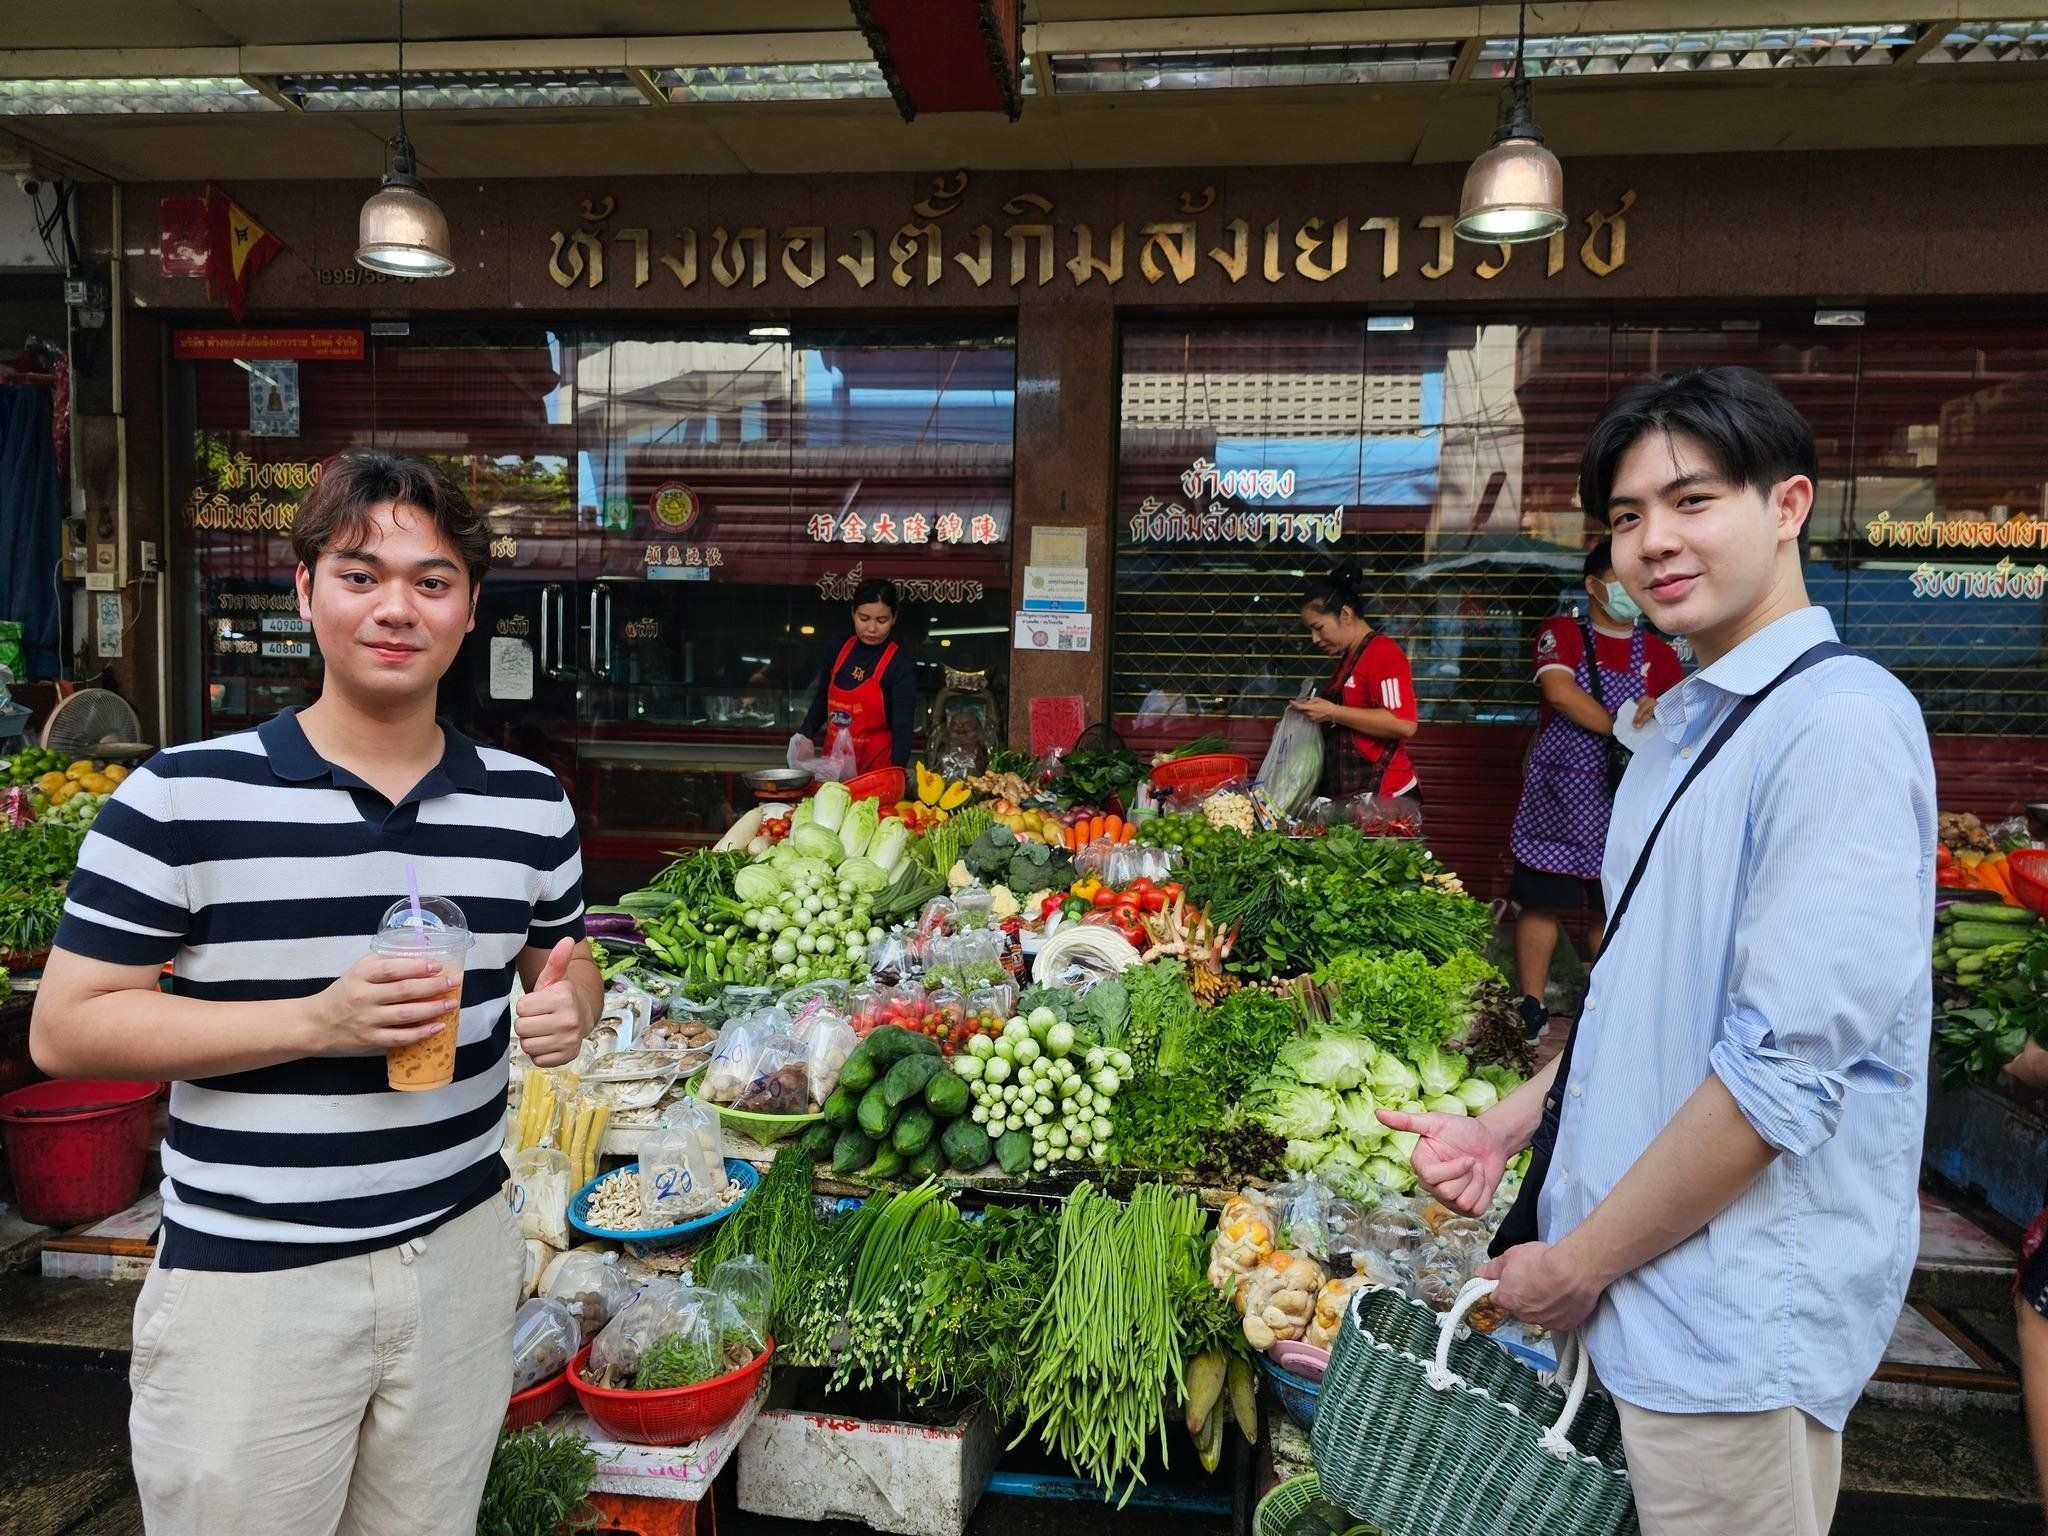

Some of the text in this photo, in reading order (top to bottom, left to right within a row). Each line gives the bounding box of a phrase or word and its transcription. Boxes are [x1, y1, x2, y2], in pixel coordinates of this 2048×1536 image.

[223, 451, 322, 489] ห้างทอง
[1180, 457, 1295, 499] ห้างทอง
[270, 620, 303, 632] 40900
[269, 643, 303, 655] 40800
[655, 1168, 693, 1200] 20
